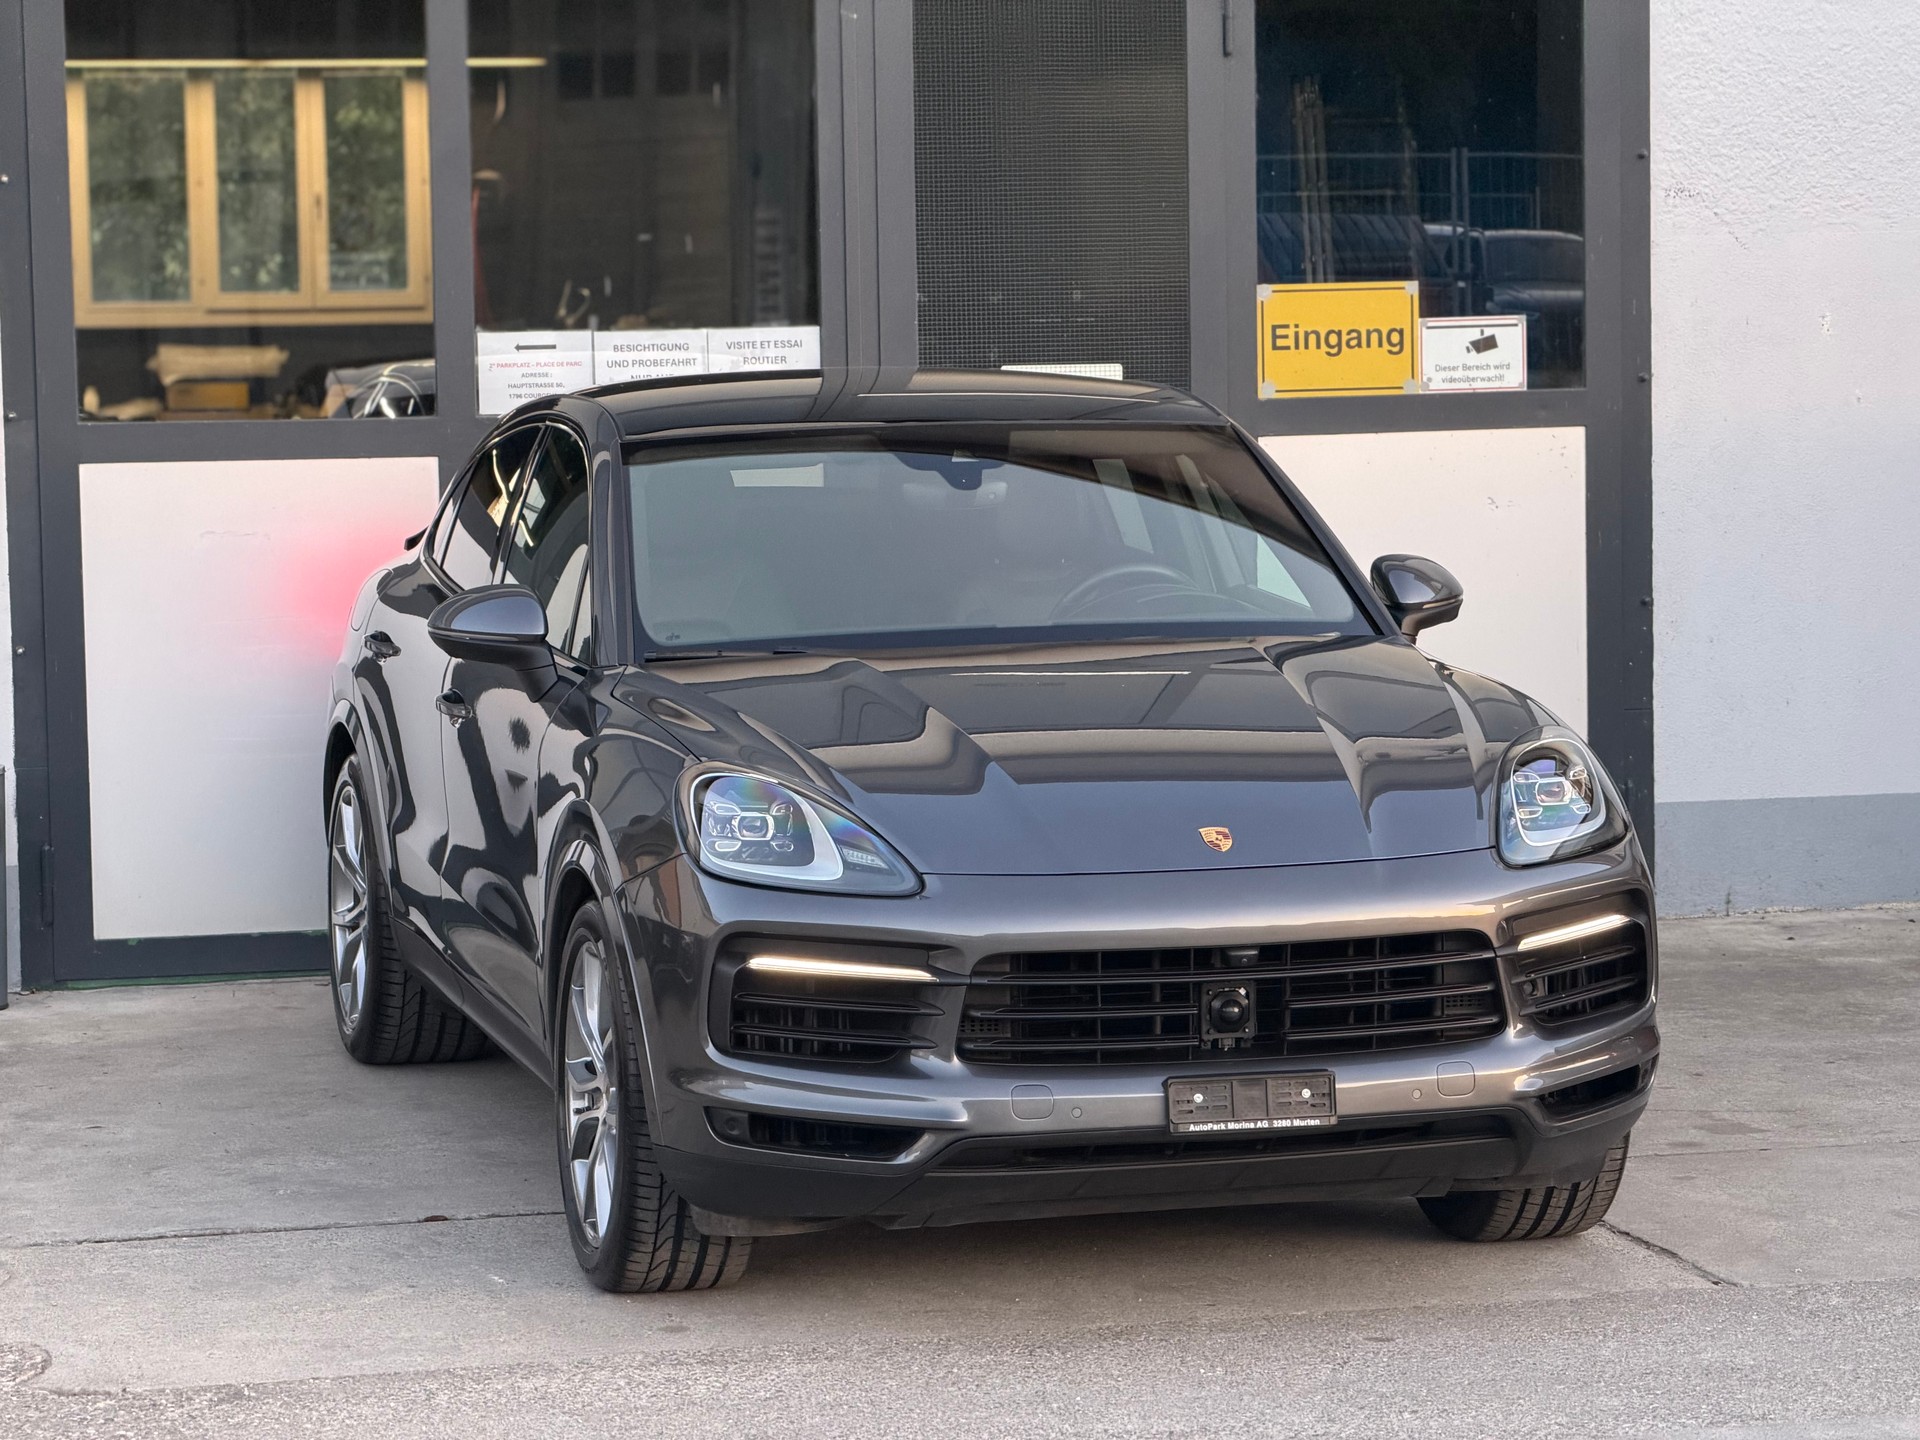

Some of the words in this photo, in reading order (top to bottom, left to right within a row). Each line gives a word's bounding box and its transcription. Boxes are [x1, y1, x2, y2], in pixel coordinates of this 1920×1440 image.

[726, 340, 758, 350] VISITE
[760, 340, 771, 349] ET
[774, 339, 803, 349] ESSAI
[1270, 324, 1405, 357] Eingang
[613, 342, 690, 353] BESICHTIGUNG
[606, 360, 629, 369] UND
[631, 358, 697, 368] PROBEFAHRT
[743, 355, 787, 365] ROUTIER
[1435, 364, 1460, 372] Dieser
[1461, 362, 1492, 371] Bereich
[1493, 362, 1511, 370] wird
[1441, 373, 1505, 384] videoüberwacht!
[1189, 1123, 1226, 1132] AutoPark
[1256, 1120, 1269, 1128] AG
[1292, 1118, 1321, 1127] Murten
